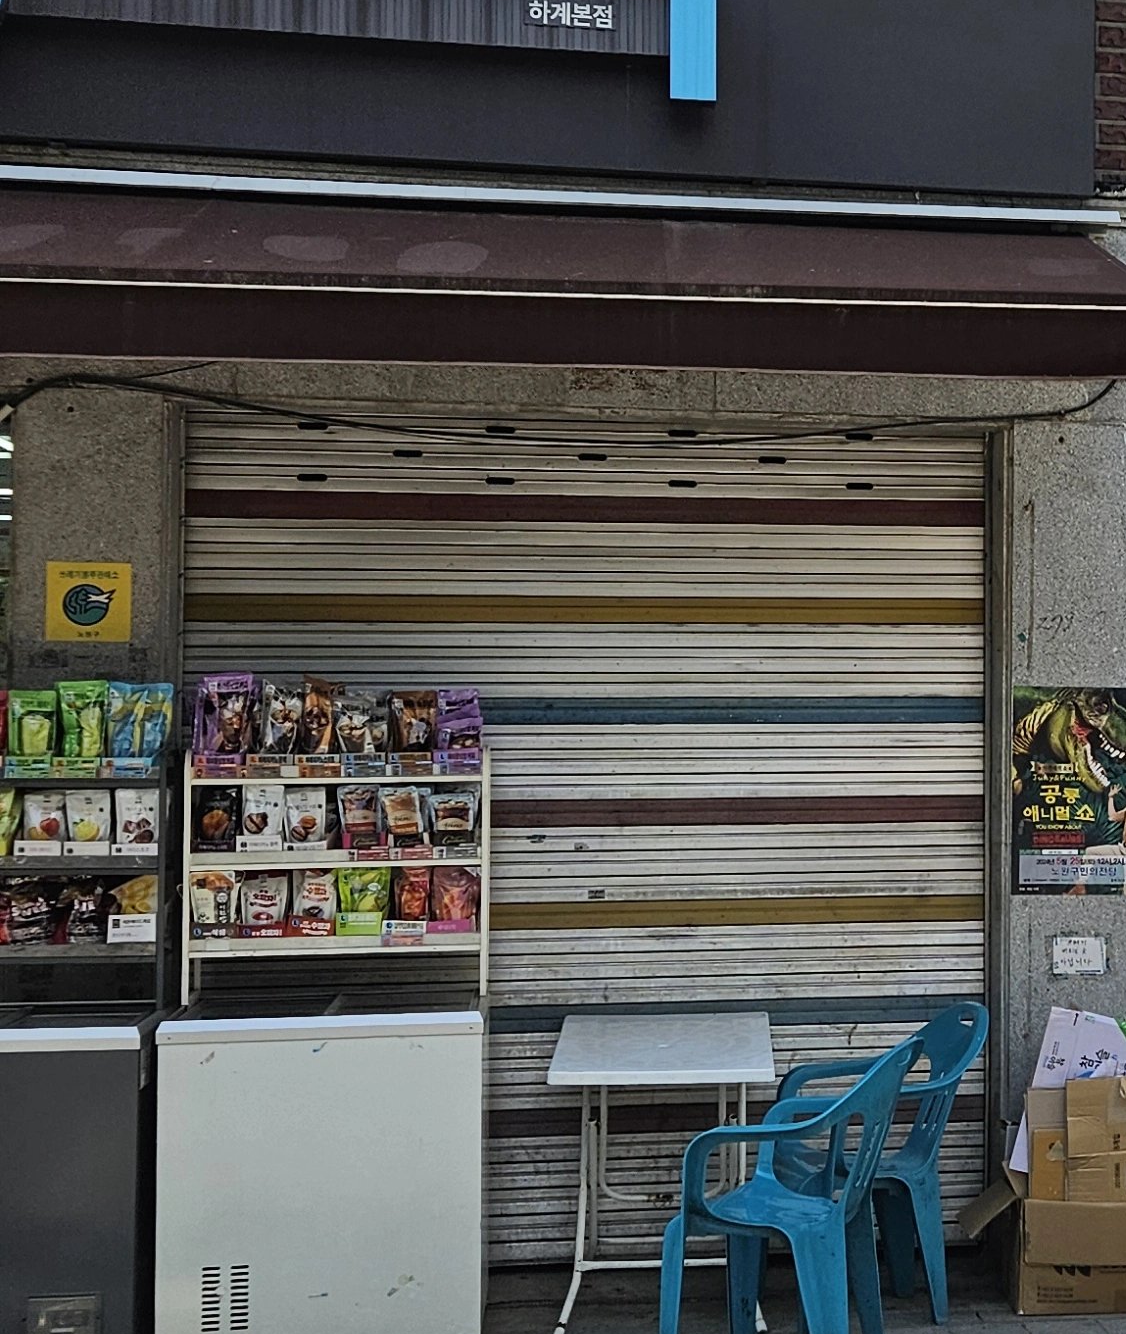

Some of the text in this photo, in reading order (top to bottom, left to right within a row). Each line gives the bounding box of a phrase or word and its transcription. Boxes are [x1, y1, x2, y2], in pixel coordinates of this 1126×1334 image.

[528, 0, 613, 29] 하계본점
[1022, 803, 1096, 822] 애니멀 쇼
